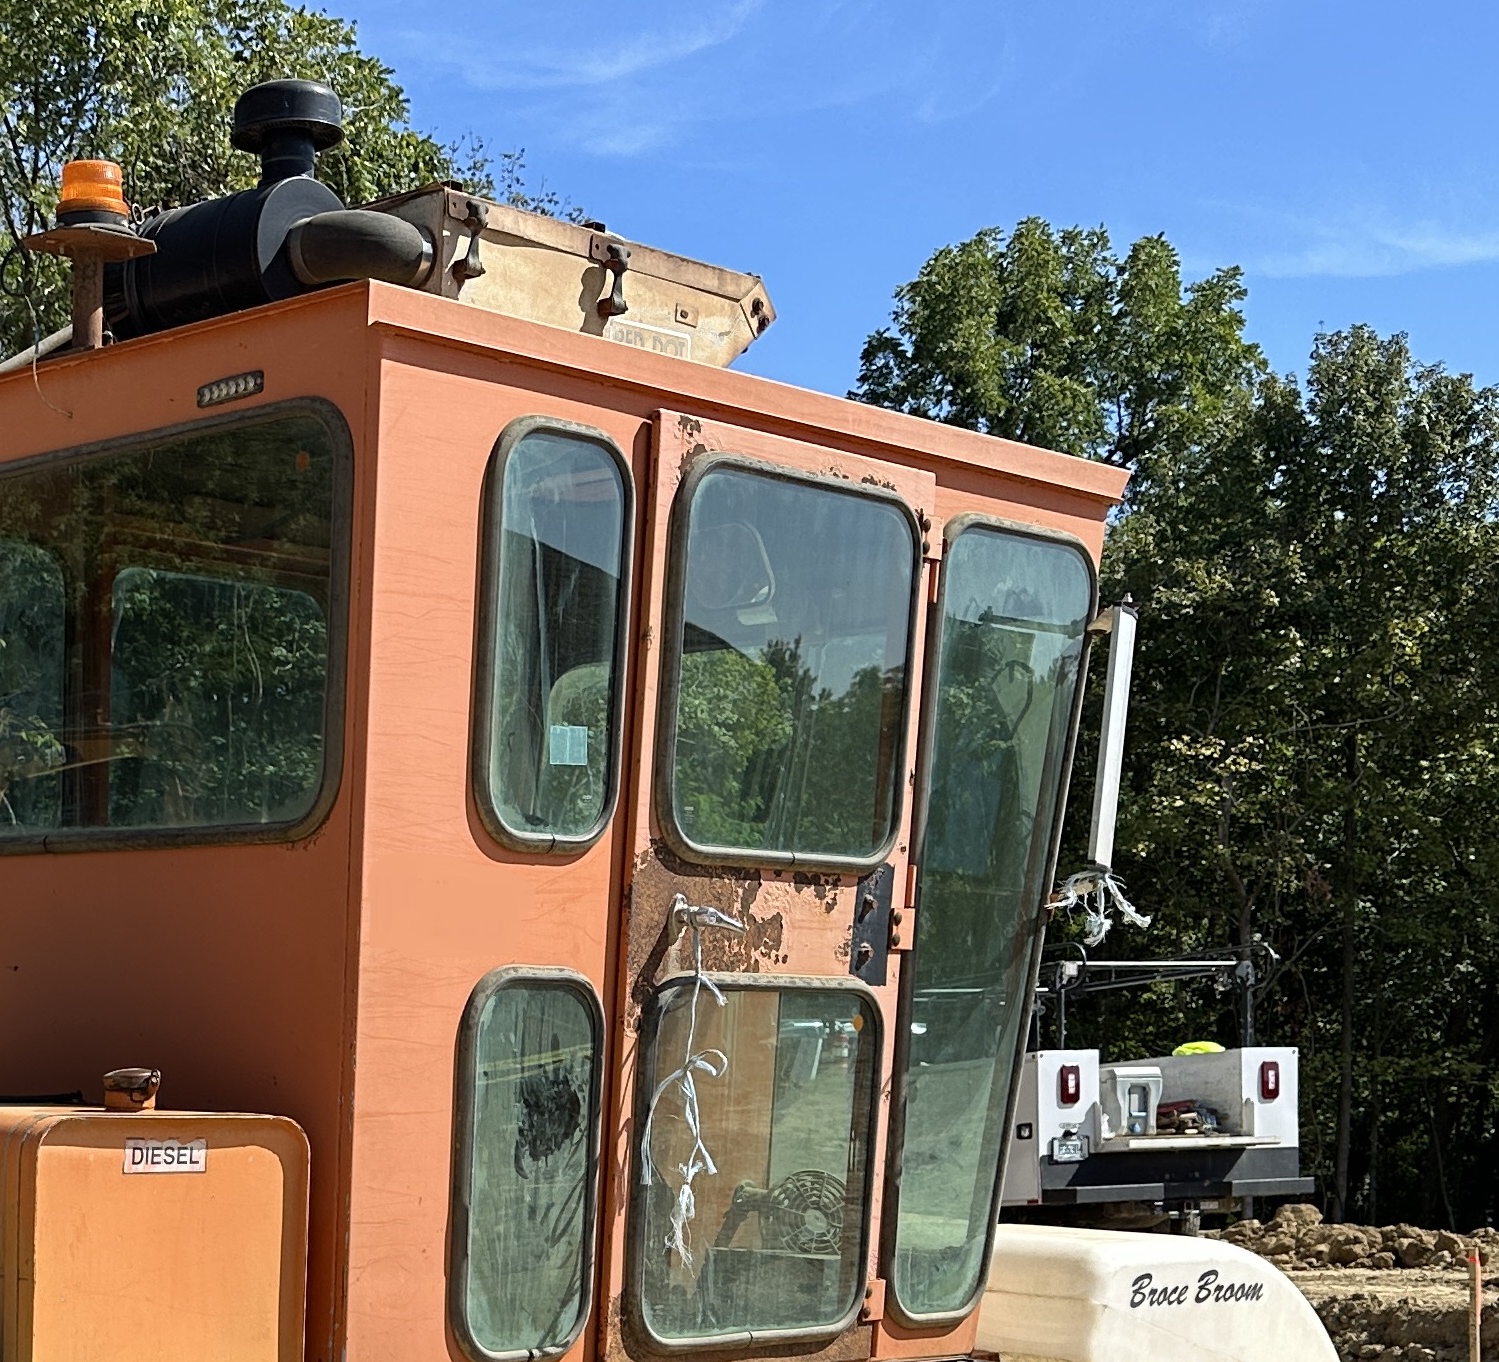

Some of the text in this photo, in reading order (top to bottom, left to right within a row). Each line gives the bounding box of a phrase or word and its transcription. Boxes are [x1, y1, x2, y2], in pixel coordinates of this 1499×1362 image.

[131, 1146, 200, 1166] DIESEL
[1129, 1269, 1264, 1309] Broce Broom
